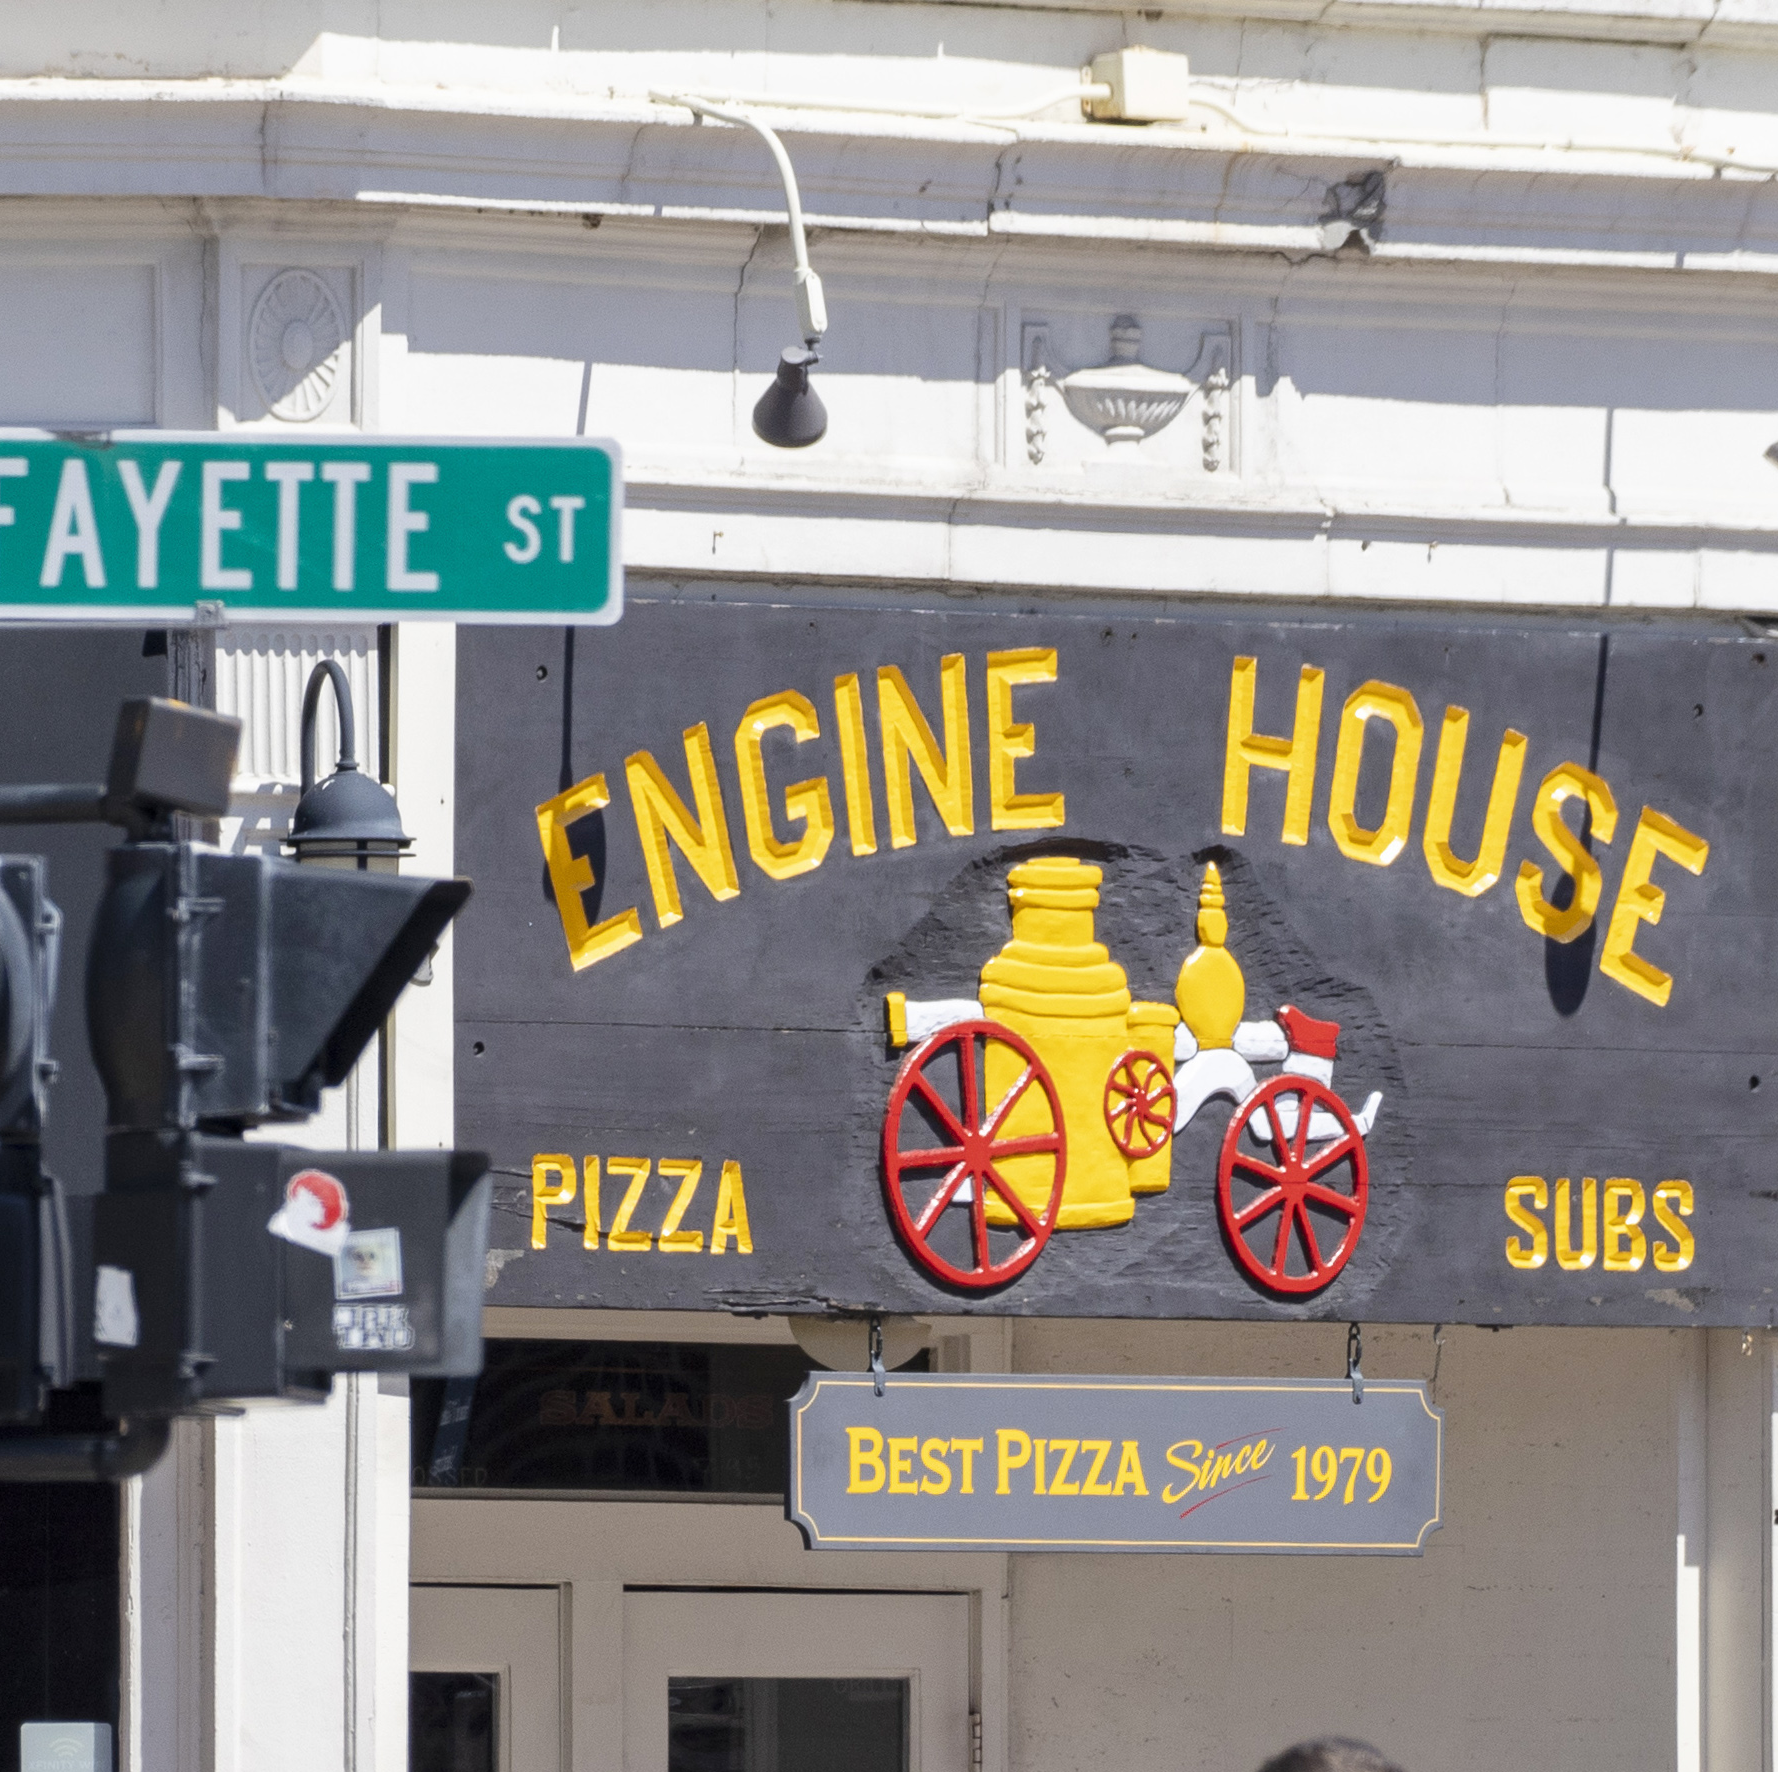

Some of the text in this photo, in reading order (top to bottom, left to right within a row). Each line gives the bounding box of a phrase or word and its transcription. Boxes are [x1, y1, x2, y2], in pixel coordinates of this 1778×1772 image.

[503, 495, 585, 563] ST
[535, 646, 1710, 1008] ENGINE HOUSE
[530, 1153, 755, 1257] PIZZA
[1504, 1175, 1698, 1273] SUBS
[539, 1389, 775, 1429] SALADS
[845, 1426, 1393, 1505] BEST PIZZA Since 1979
